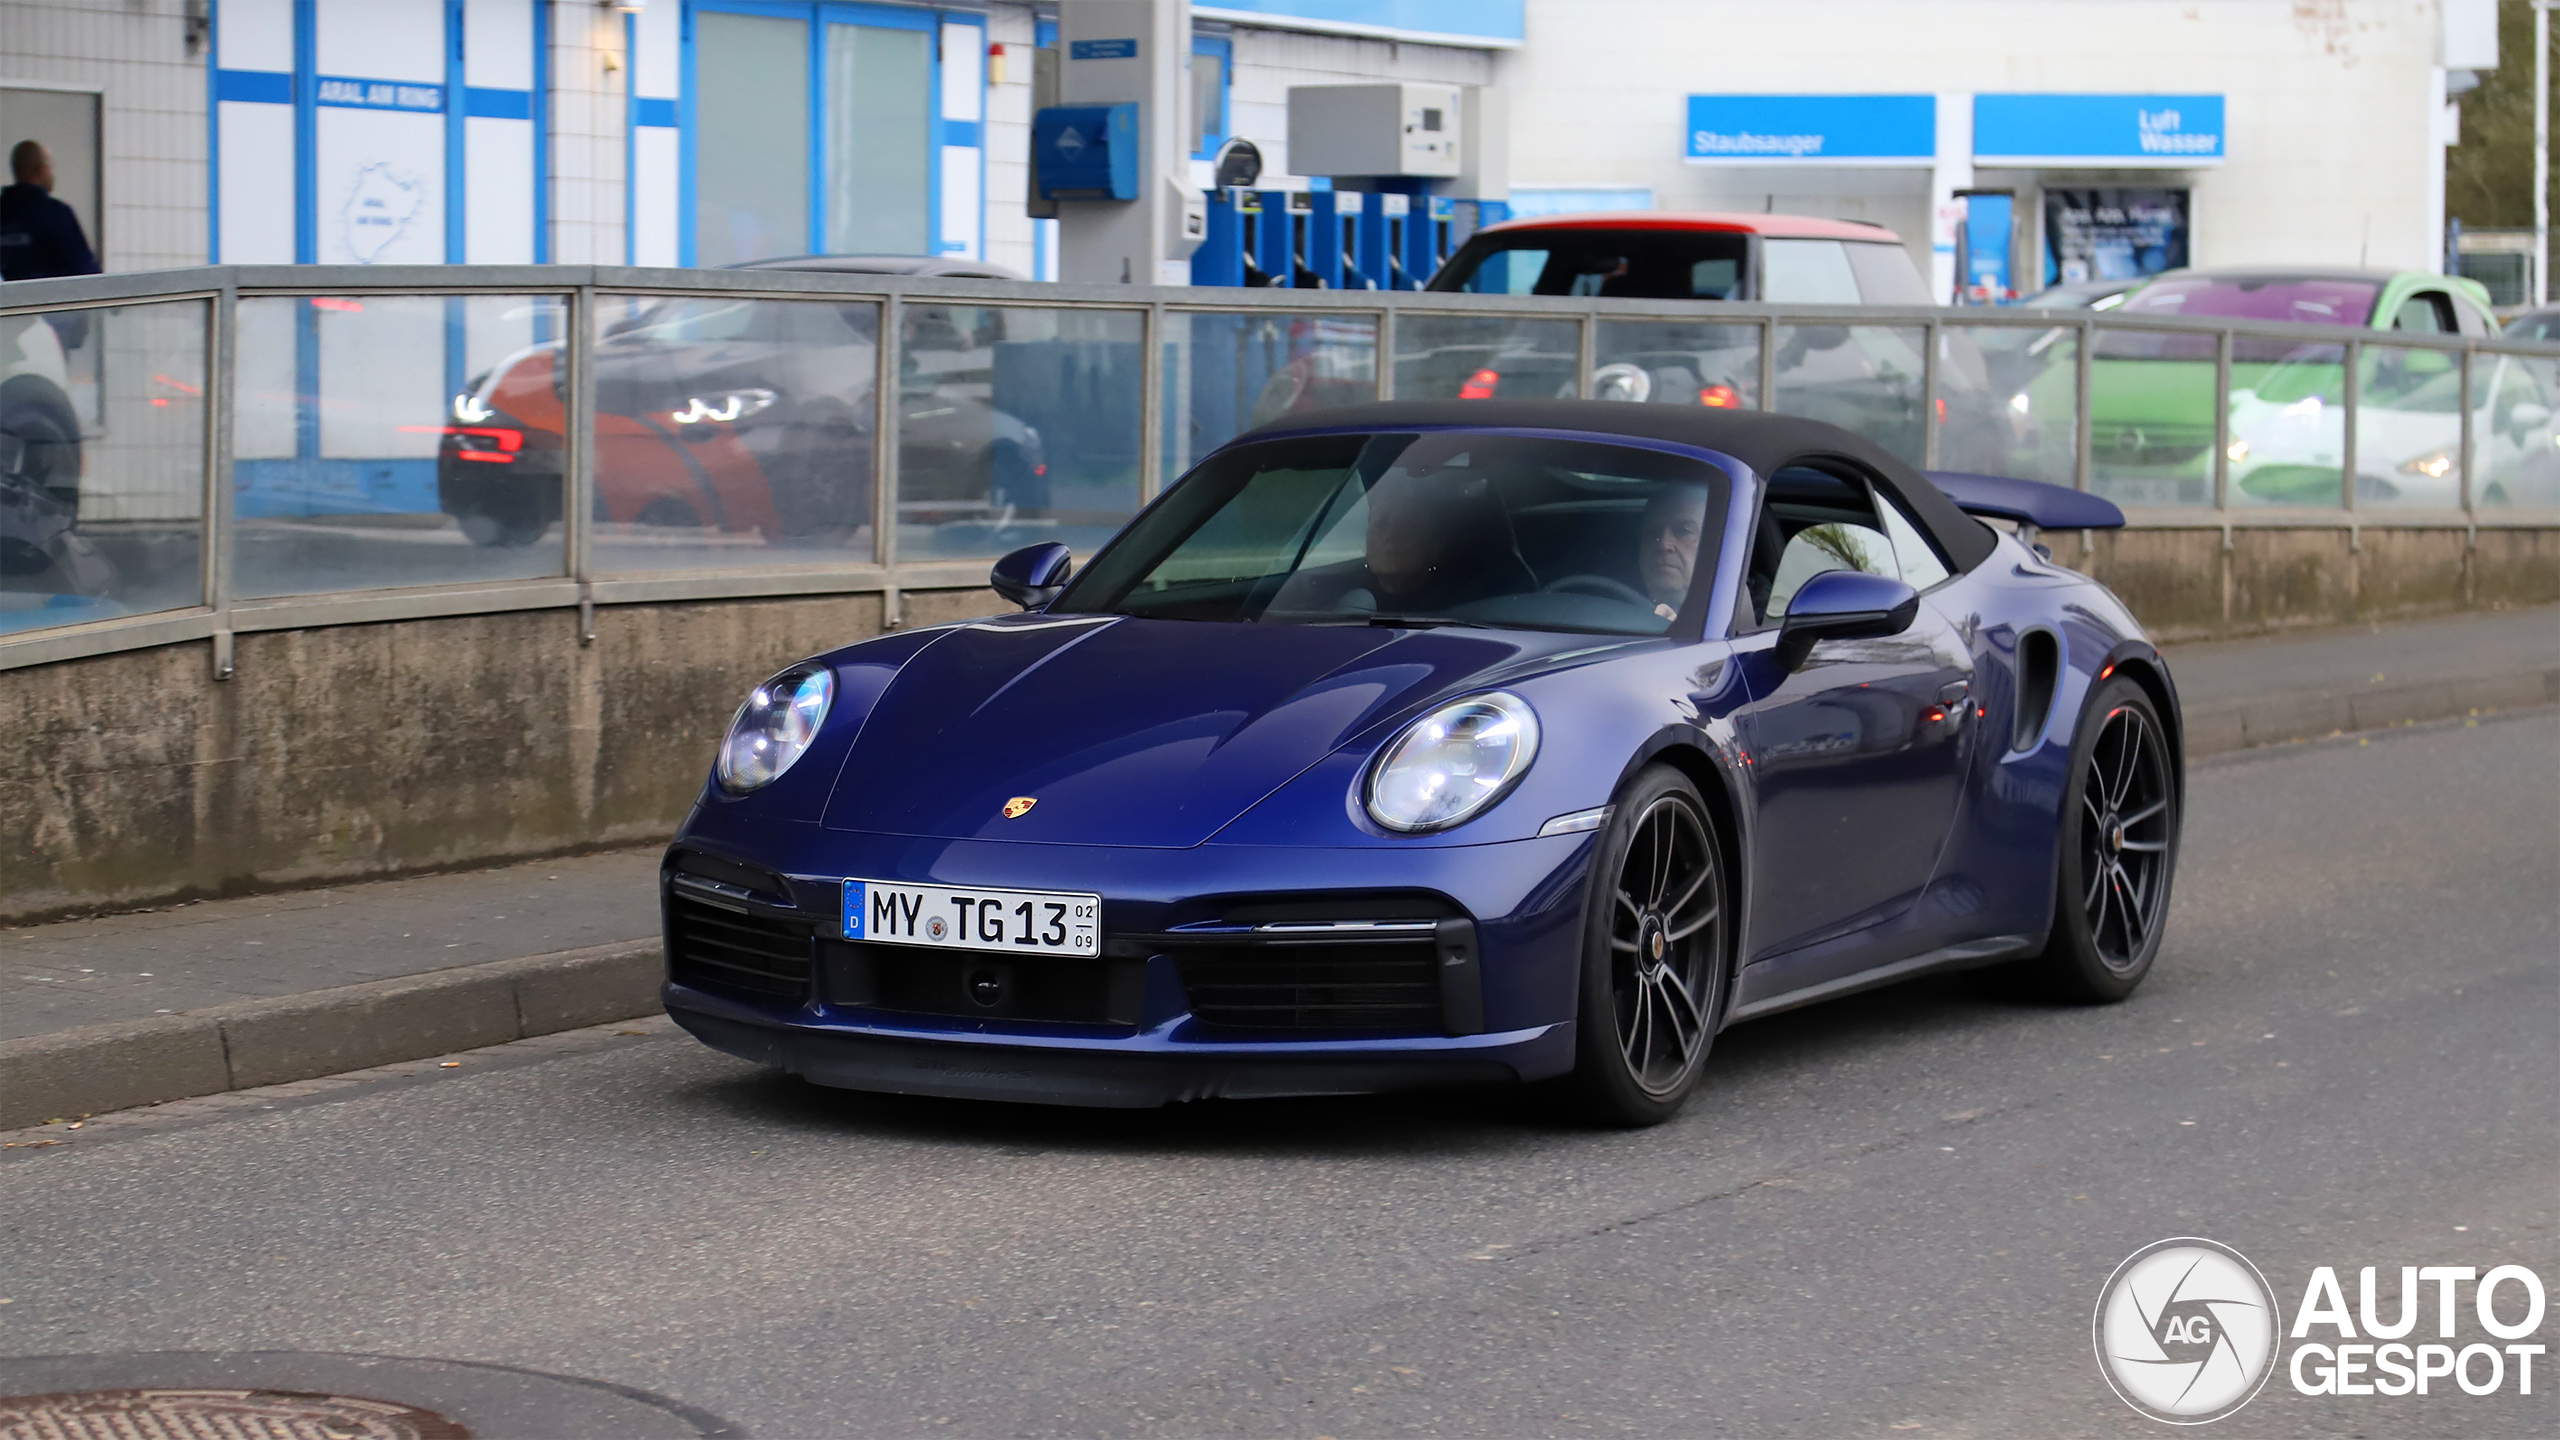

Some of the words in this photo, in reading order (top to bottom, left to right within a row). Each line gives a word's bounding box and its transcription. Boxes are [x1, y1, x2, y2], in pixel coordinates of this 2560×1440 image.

[318, 80, 364, 102] ARAL
[366, 84, 394, 104] AM
[397, 86, 439, 109] RING
[2139, 109, 2180, 131] Luft
[1695, 130, 1824, 156] Staubsauger
[2139, 131, 2218, 153] Wasser
[850, 916, 859, 929] D
[872, 890, 924, 937] MY
[1075, 905, 1093, 918] 02
[1075, 934, 1093, 949] 09
